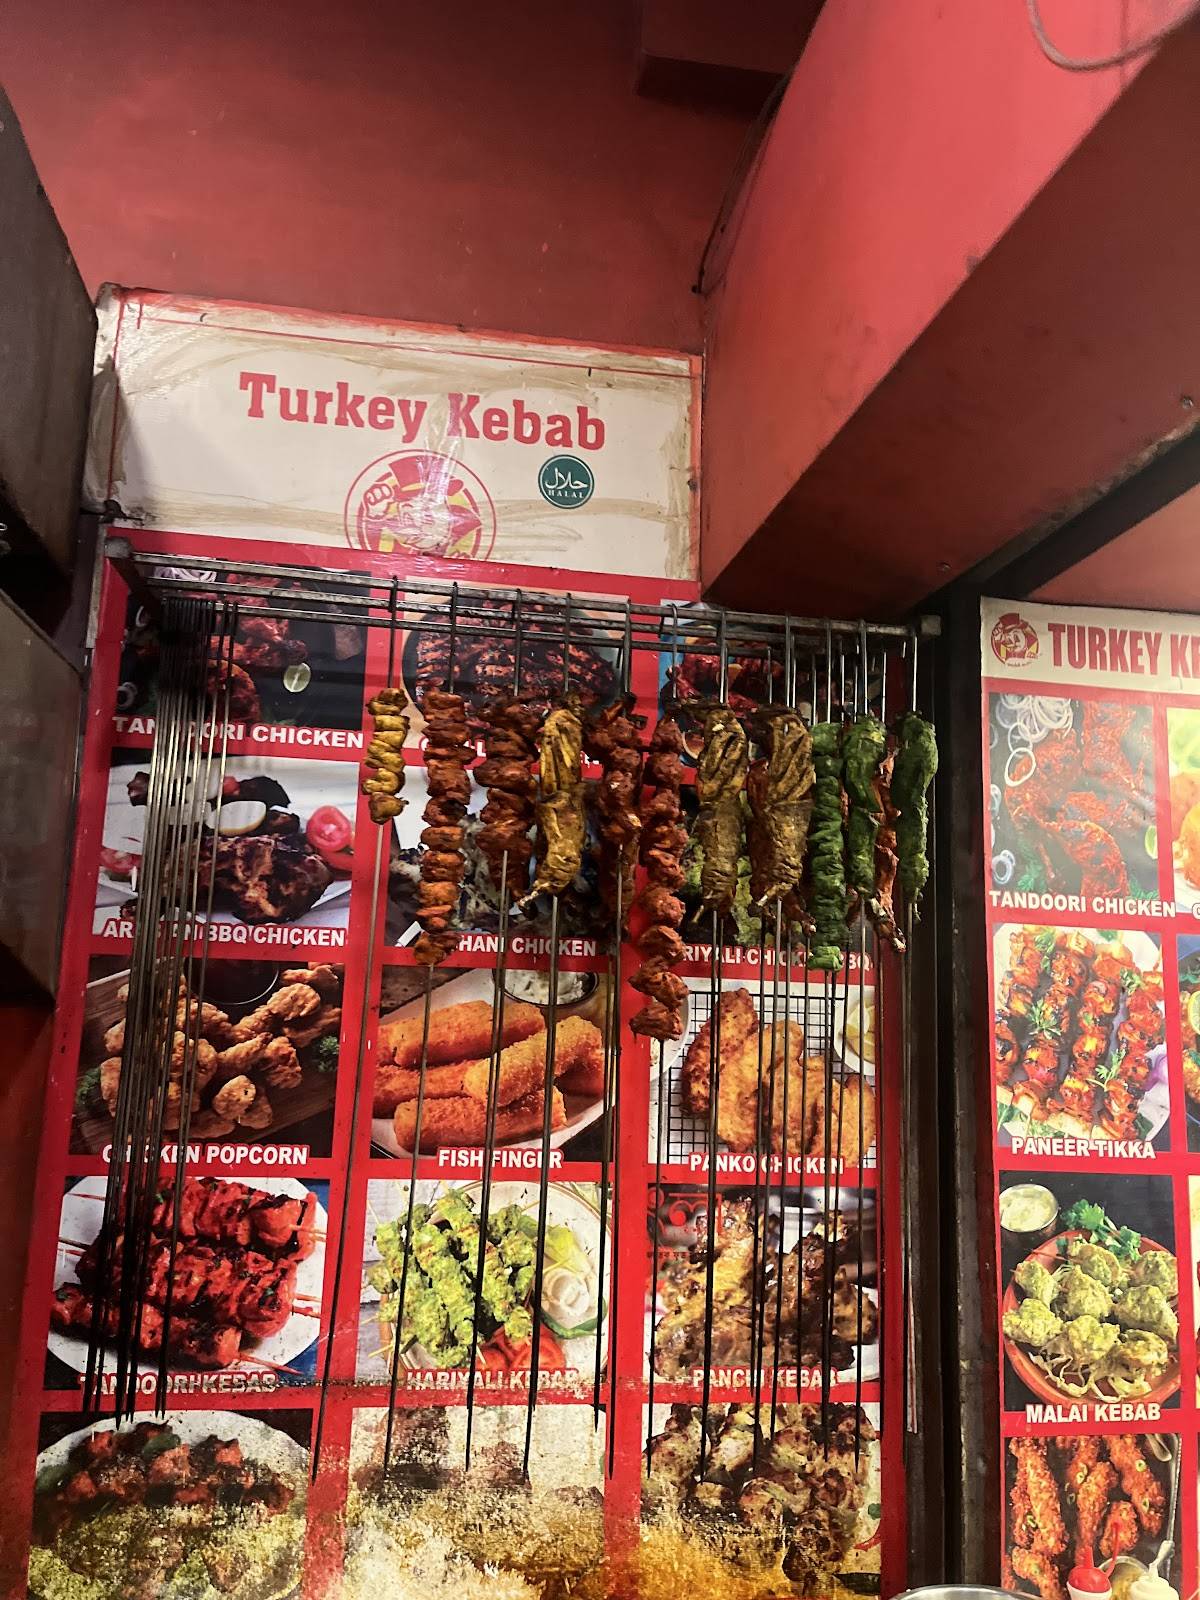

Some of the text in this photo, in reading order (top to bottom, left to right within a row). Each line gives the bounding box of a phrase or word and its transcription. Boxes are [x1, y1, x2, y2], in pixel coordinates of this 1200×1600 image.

[239, 371, 605, 450] Turkey Kebab
[545, 467, 588, 489] حلال
[548, 489, 584, 499] HALAL
[1048, 622, 1162, 676] TURKEY
[112, 716, 364, 749] TANORI CHICKEN
[989, 891, 1086, 912] TANDOORI
[1092, 898, 1176, 918] CHICKEN
[207, 924, 247, 944] BBQ
[253, 926, 345, 946] CHICKEN
[511, 937, 597, 957] CHICKEN
[206, 1145, 308, 1165] POPCORN
[438, 1149, 483, 1167] FISH
[1011, 1137, 1157, 1159] PANEER TIKKA
[690, 1154, 844, 1175] PANKO CHICKEN
[1025, 1403, 1161, 1424] MALAI KEBAB
